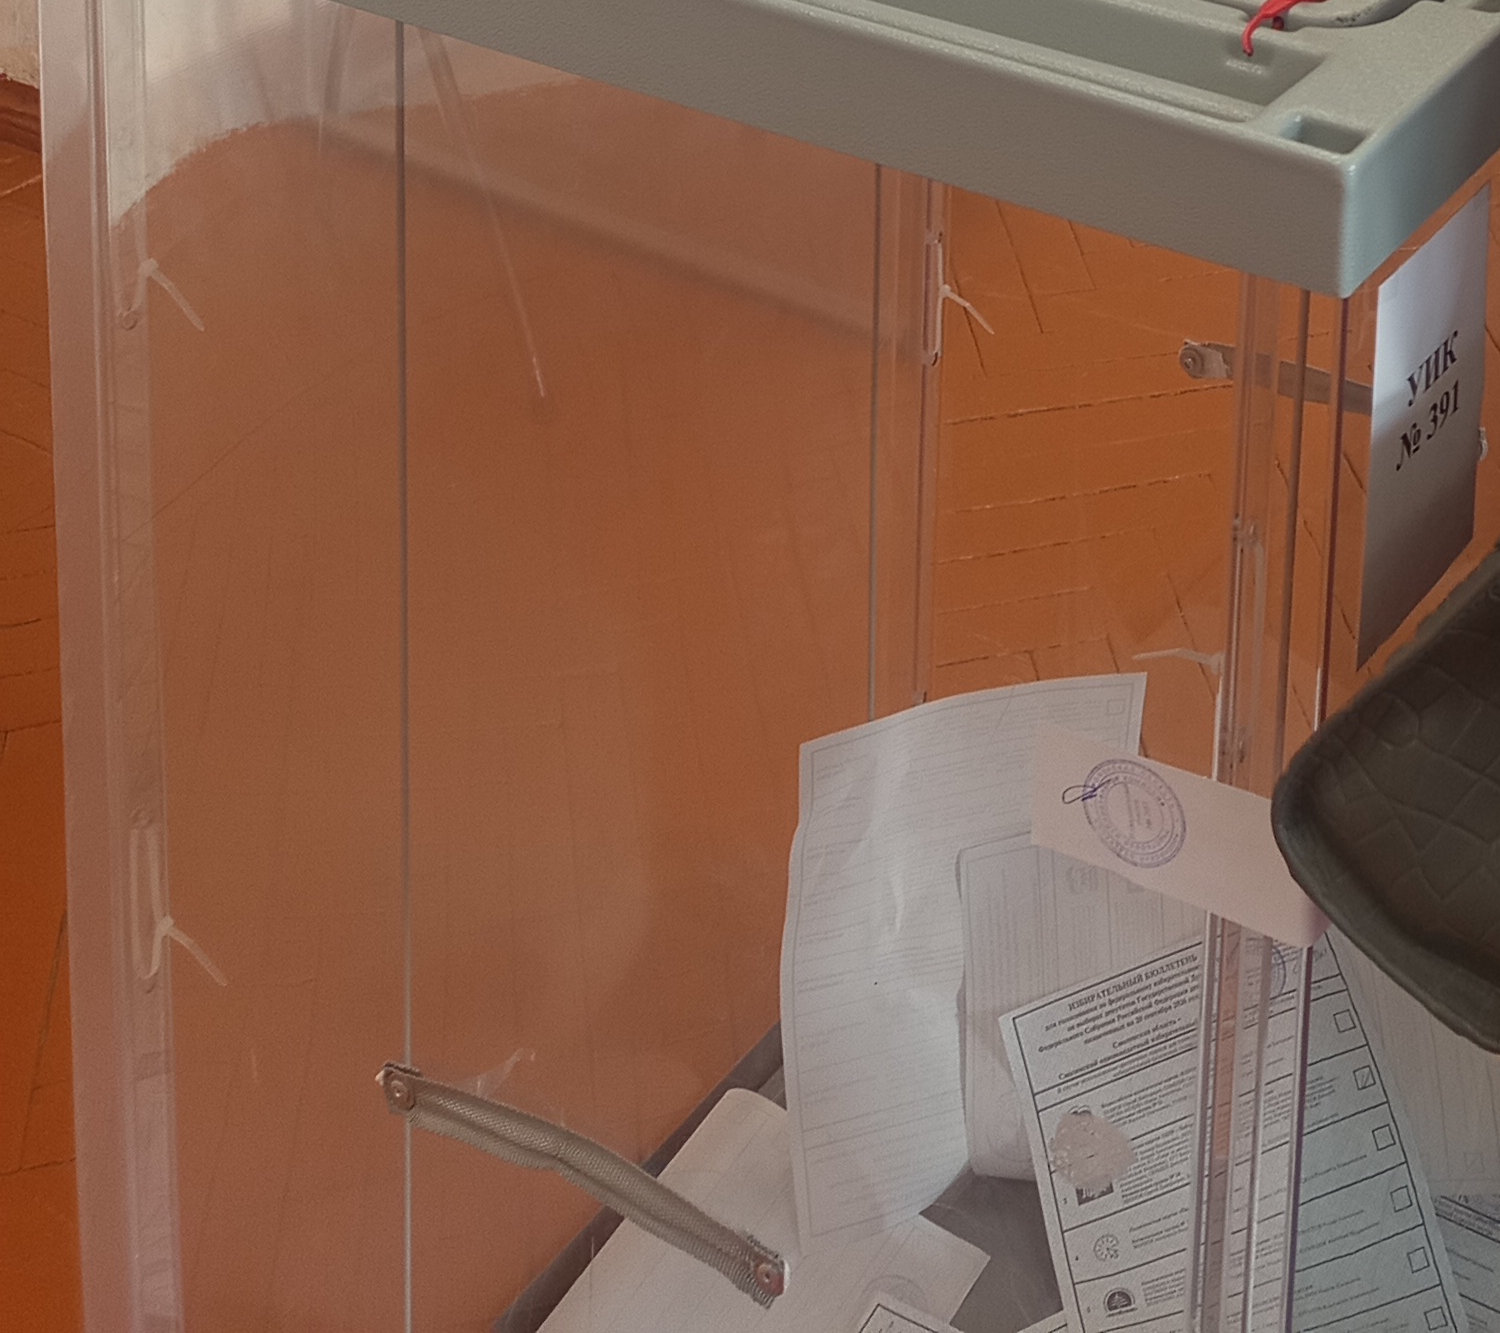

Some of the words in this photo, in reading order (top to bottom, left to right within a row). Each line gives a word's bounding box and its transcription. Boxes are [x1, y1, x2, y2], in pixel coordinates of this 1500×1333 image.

[1407, 331, 1458, 407] УИК
[1396, 422, 1421, 471] №
[1427, 379, 1459, 440] 391
[1067, 972, 1144, 1012] ИЗБИРАТЕЛЬНЫЙ
[1143, 952, 1198, 981] БЮЛЛЕТЕНЬ
